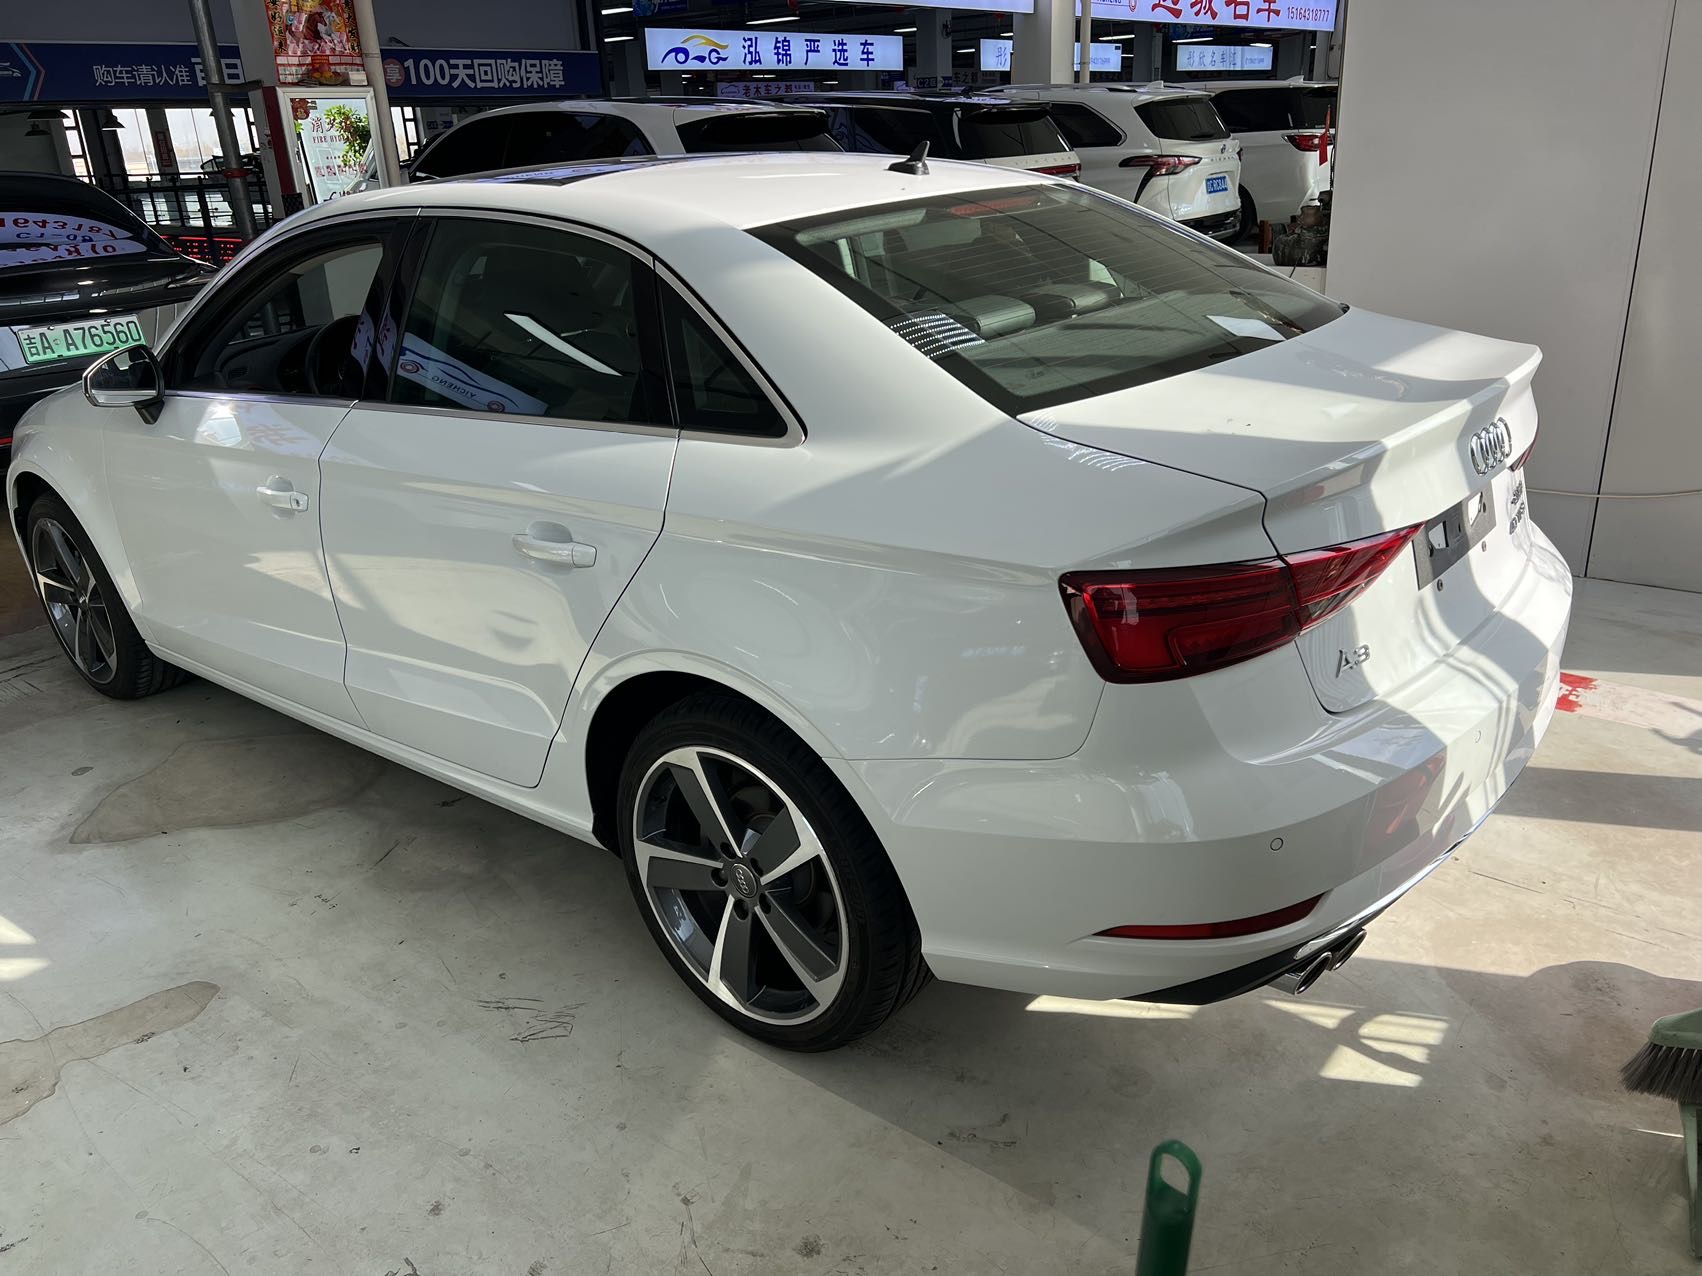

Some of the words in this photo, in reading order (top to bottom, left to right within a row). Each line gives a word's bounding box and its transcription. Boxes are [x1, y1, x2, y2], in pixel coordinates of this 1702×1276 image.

[1287, 6, 1330, 22] 15164318777
[742, 36, 876, 67] 泓锦严选车
[93, 64, 192, 87] 购车请认准
[404, 58, 566, 89] 100天回购保障
[1335, 644, 1371, 679] A3
